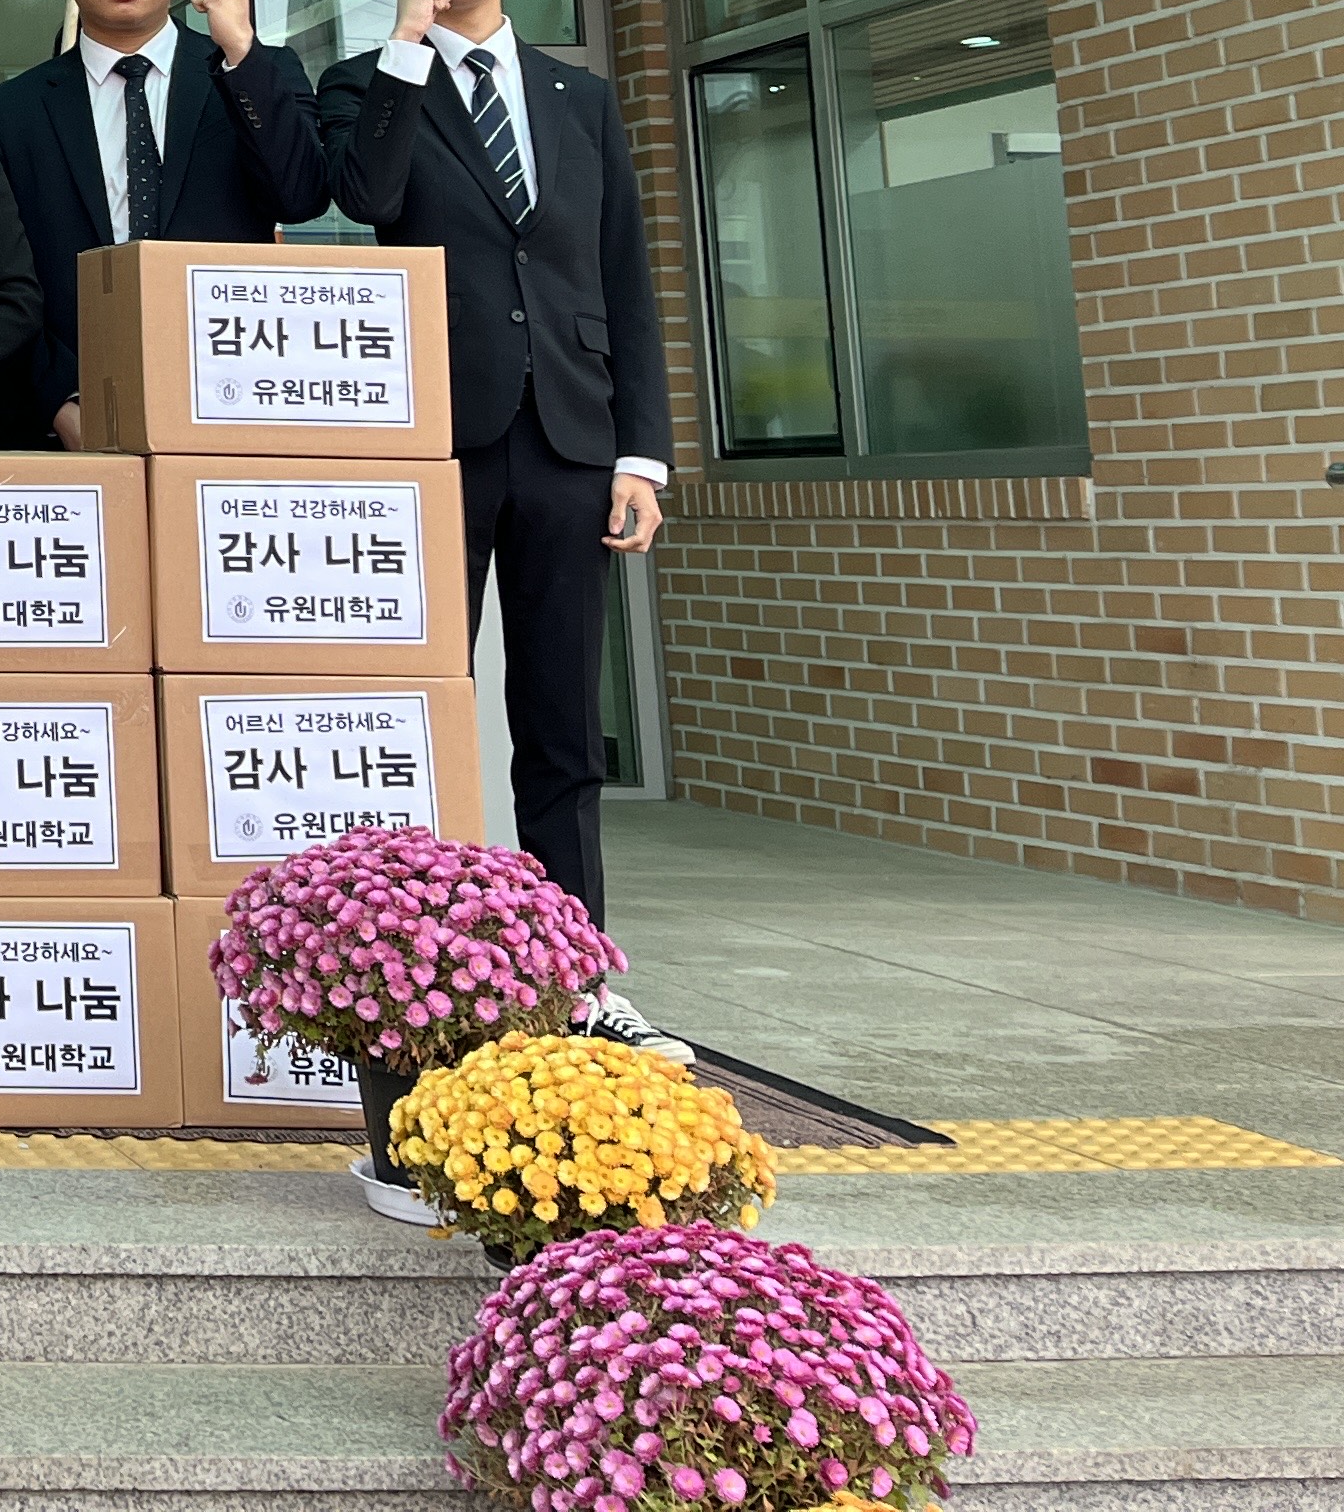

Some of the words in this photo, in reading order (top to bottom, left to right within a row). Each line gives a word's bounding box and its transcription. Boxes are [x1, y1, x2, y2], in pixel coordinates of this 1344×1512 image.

[211, 284, 268, 303] 어르신
[279, 286, 383, 305] 건강하세요~
[207, 316, 289, 357] 감사
[313, 318, 395, 360] 나눔
[253, 379, 389, 407] 유원대학교
[221, 499, 278, 518] 어르신
[290, 500, 397, 520] 건강하세요~
[8, 537, 89, 578] 나눔
[218, 531, 301, 573] 감사
[325, 532, 407, 575] 나눔
[264, 595, 403, 624] 유원대학교
[226, 713, 284, 734] 어르신
[295, 712, 404, 733] 건강하세요~
[17, 755, 99, 798] 나눔
[224, 747, 308, 791] 감사
[332, 746, 417, 788] 나눔
[0, 941, 112, 963] 건강하세요~
[36, 976, 121, 1021] 나눔
